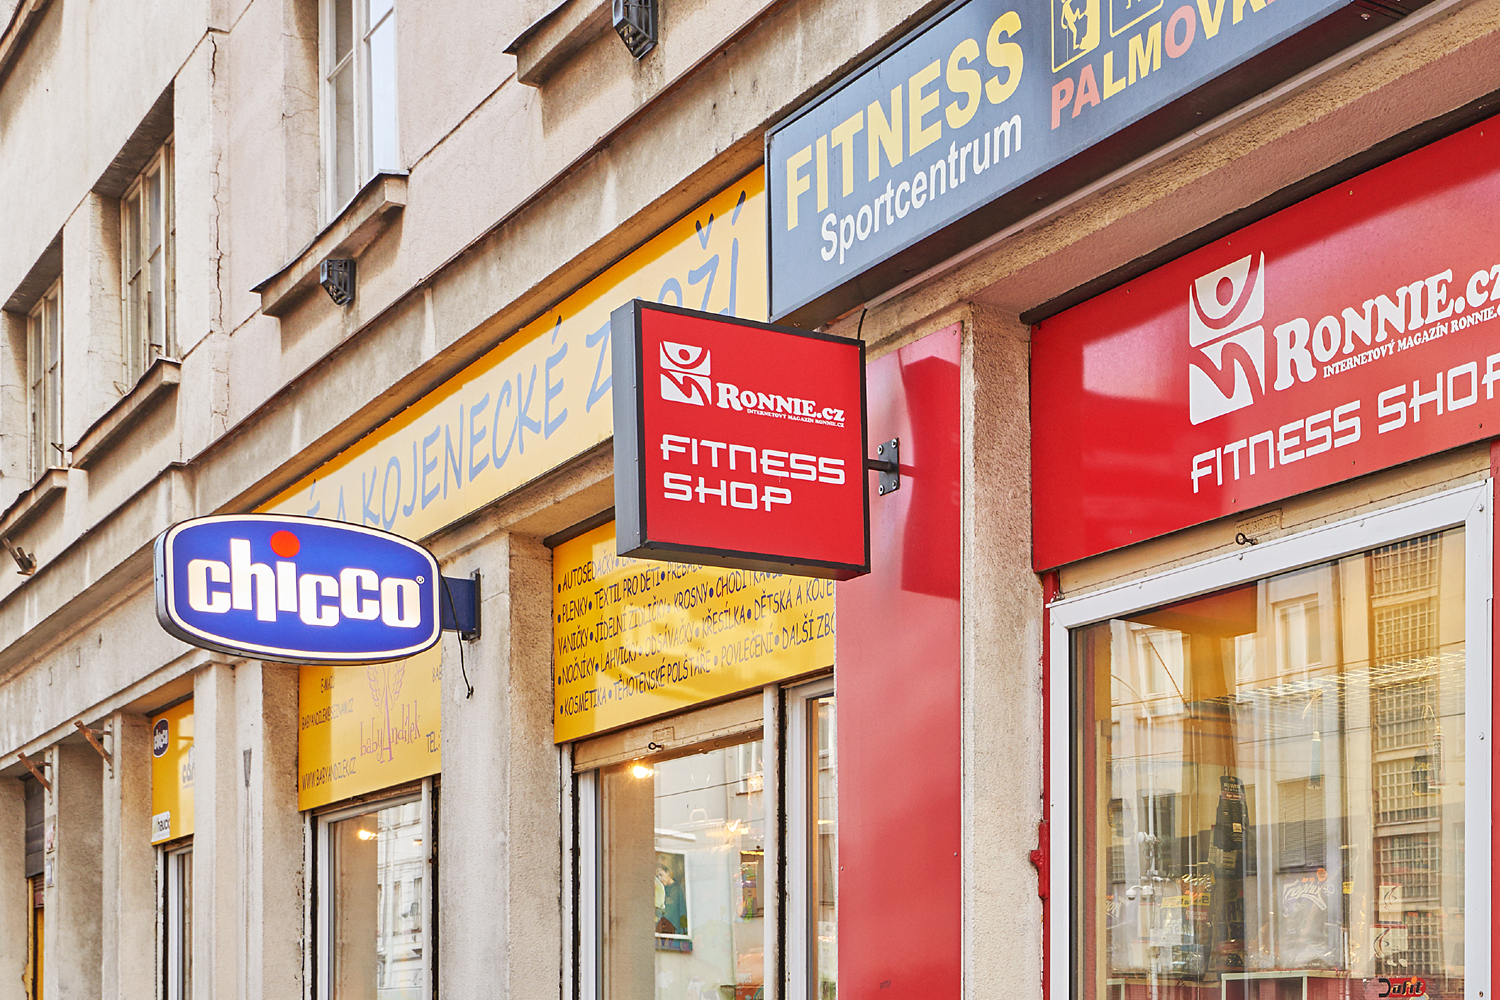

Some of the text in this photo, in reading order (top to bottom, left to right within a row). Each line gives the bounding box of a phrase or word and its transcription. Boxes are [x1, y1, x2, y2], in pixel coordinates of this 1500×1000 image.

[1051, 0, 1276, 130] PALMOV
[787, 11, 1024, 231] FITNESS
[820, 114, 1022, 265] Sportcentrum
[1323, 341, 1395, 378] INTERNETOVÝ
[1397, 320, 1449, 352] MAGAZÍN
[361, 316, 569, 532] KOJENECKÉ
[660, 433, 845, 485] FITNESS
[747, 408, 787, 419] INTERNETOVÝ
[788, 415, 815, 423] MAGAZÍN
[1190, 400, 1361, 494] FITNESS
[663, 471, 792, 512] SHOP
[188, 530, 421, 628] chicco
[558, 624, 589, 656] VANIČKY
[594, 606, 627, 643] JÍDELNÍ
[673, 582, 709, 614] KROSNY
[562, 596, 589, 623] PLENKY
[594, 582, 622, 610] TEXTIL
[623, 575, 637, 599] PRO
[640, 563, 661, 593] DĚTI
[562, 653, 596, 685] NOČNÍKY
[601, 638, 640, 672] LAHVIČKY
[645, 618, 695, 657] ODSÁVAČKY
[702, 601, 746, 638] KŘESÍLKA
[754, 579, 793, 621] DĚTSKÁ
[795, 584, 803, 606] A
[564, 685, 607, 717] KOSMETIKA
[613, 657, 666, 701] TĚHOTENSKÉ
[667, 646, 711, 684] POLŠTÁŘE
[721, 623, 773, 667] POVLEČENÍ
[783, 610, 814, 650] DALŠÍ
